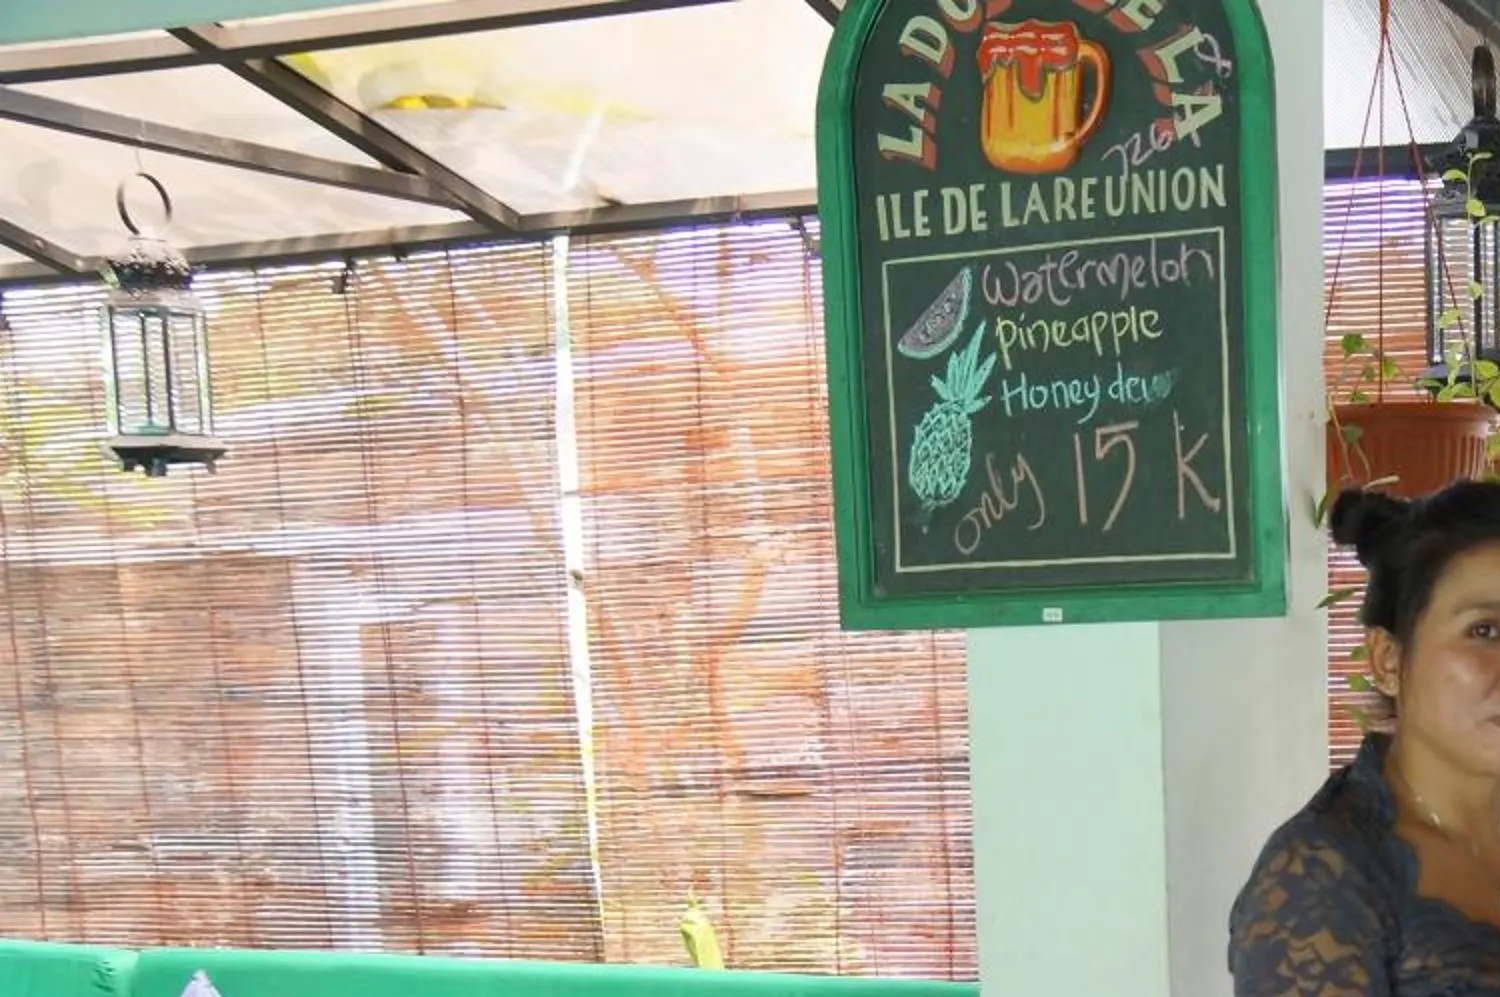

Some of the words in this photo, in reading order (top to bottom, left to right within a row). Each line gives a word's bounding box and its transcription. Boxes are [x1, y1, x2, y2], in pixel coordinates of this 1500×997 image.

[877, 82, 938, 168] LA
[876, 190, 932, 242] ILE
[940, 183, 988, 236] DE
[981, 237, 1215, 308] Watermelon
[1000, 372, 1101, 425] Honey
[1073, 420, 1140, 532] 15
